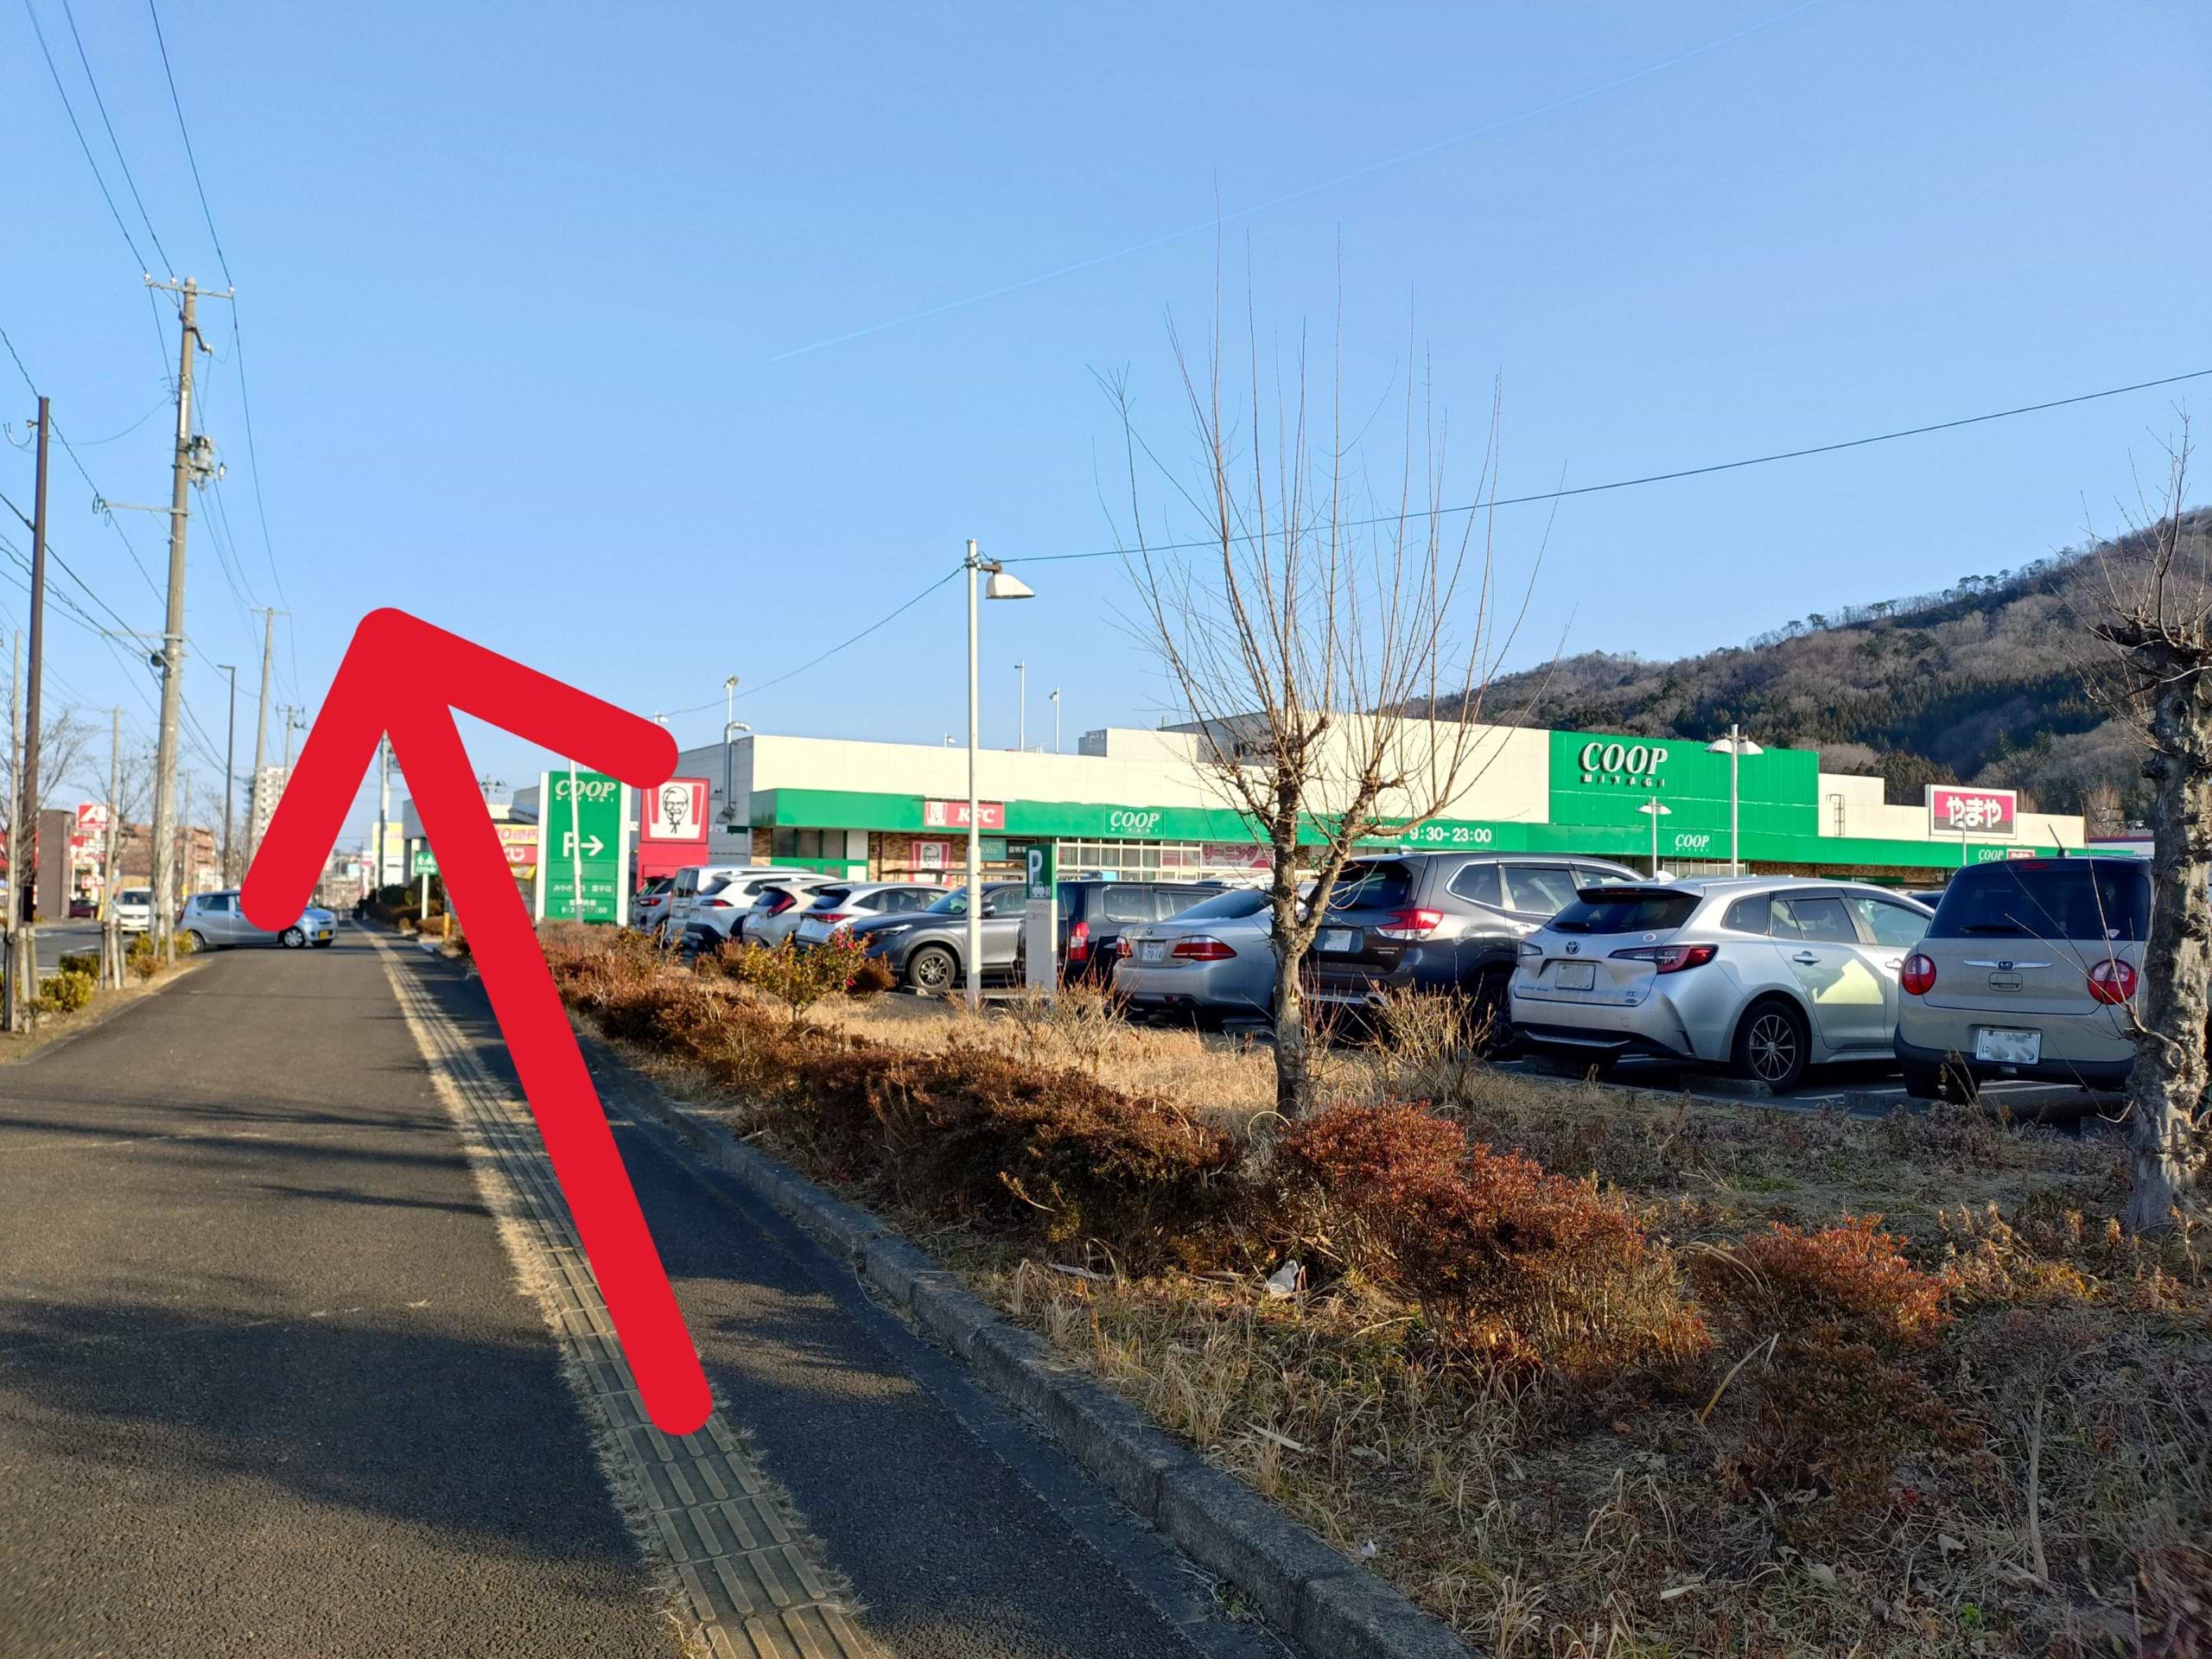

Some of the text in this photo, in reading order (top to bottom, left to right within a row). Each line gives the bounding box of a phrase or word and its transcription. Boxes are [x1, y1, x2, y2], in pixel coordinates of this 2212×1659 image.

[1582, 742, 1668, 774] COOP
[555, 779, 616, 797] COOP
[1583, 773, 1665, 787] MIYAGI
[1110, 810, 1160, 828] COOP
[1947, 795, 2003, 829] やまや
[1675, 834, 1710, 848] COOP
[1978, 849, 2004, 861] COOP
[1028, 849, 1043, 885] P
